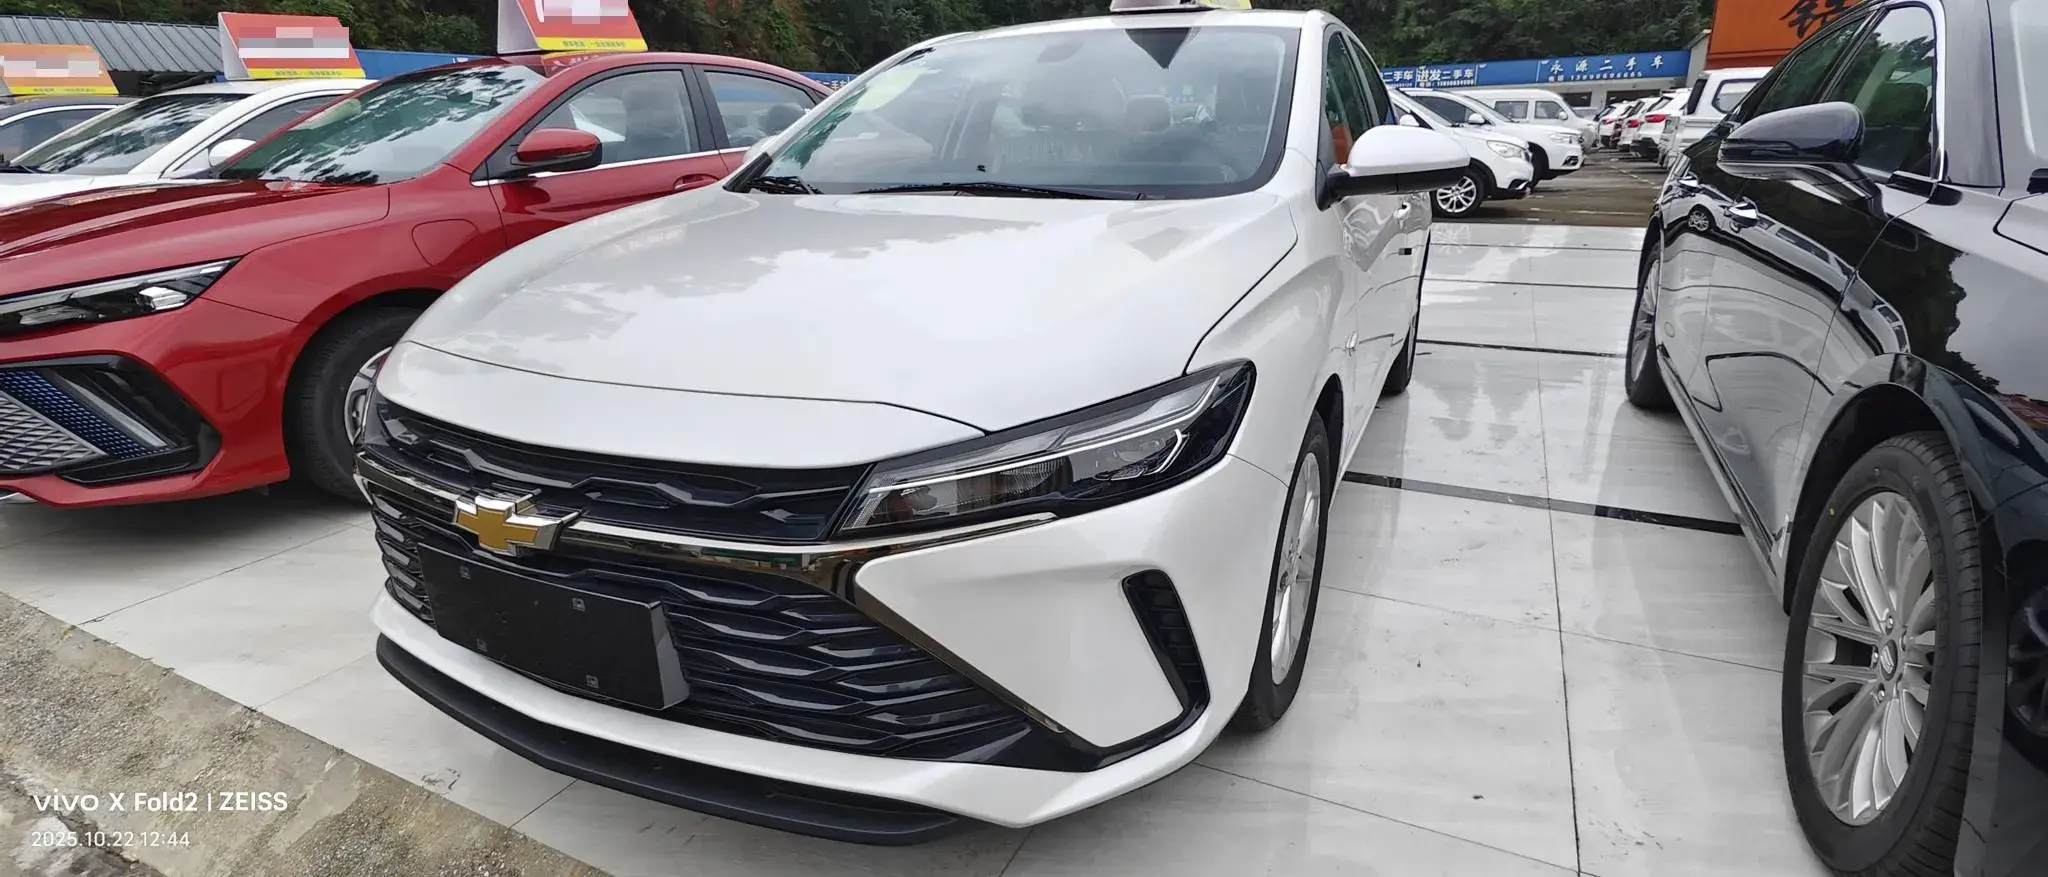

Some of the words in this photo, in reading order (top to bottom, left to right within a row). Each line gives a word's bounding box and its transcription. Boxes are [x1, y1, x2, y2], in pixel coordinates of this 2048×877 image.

[1550, 55, 1664, 74] 永源二手车
